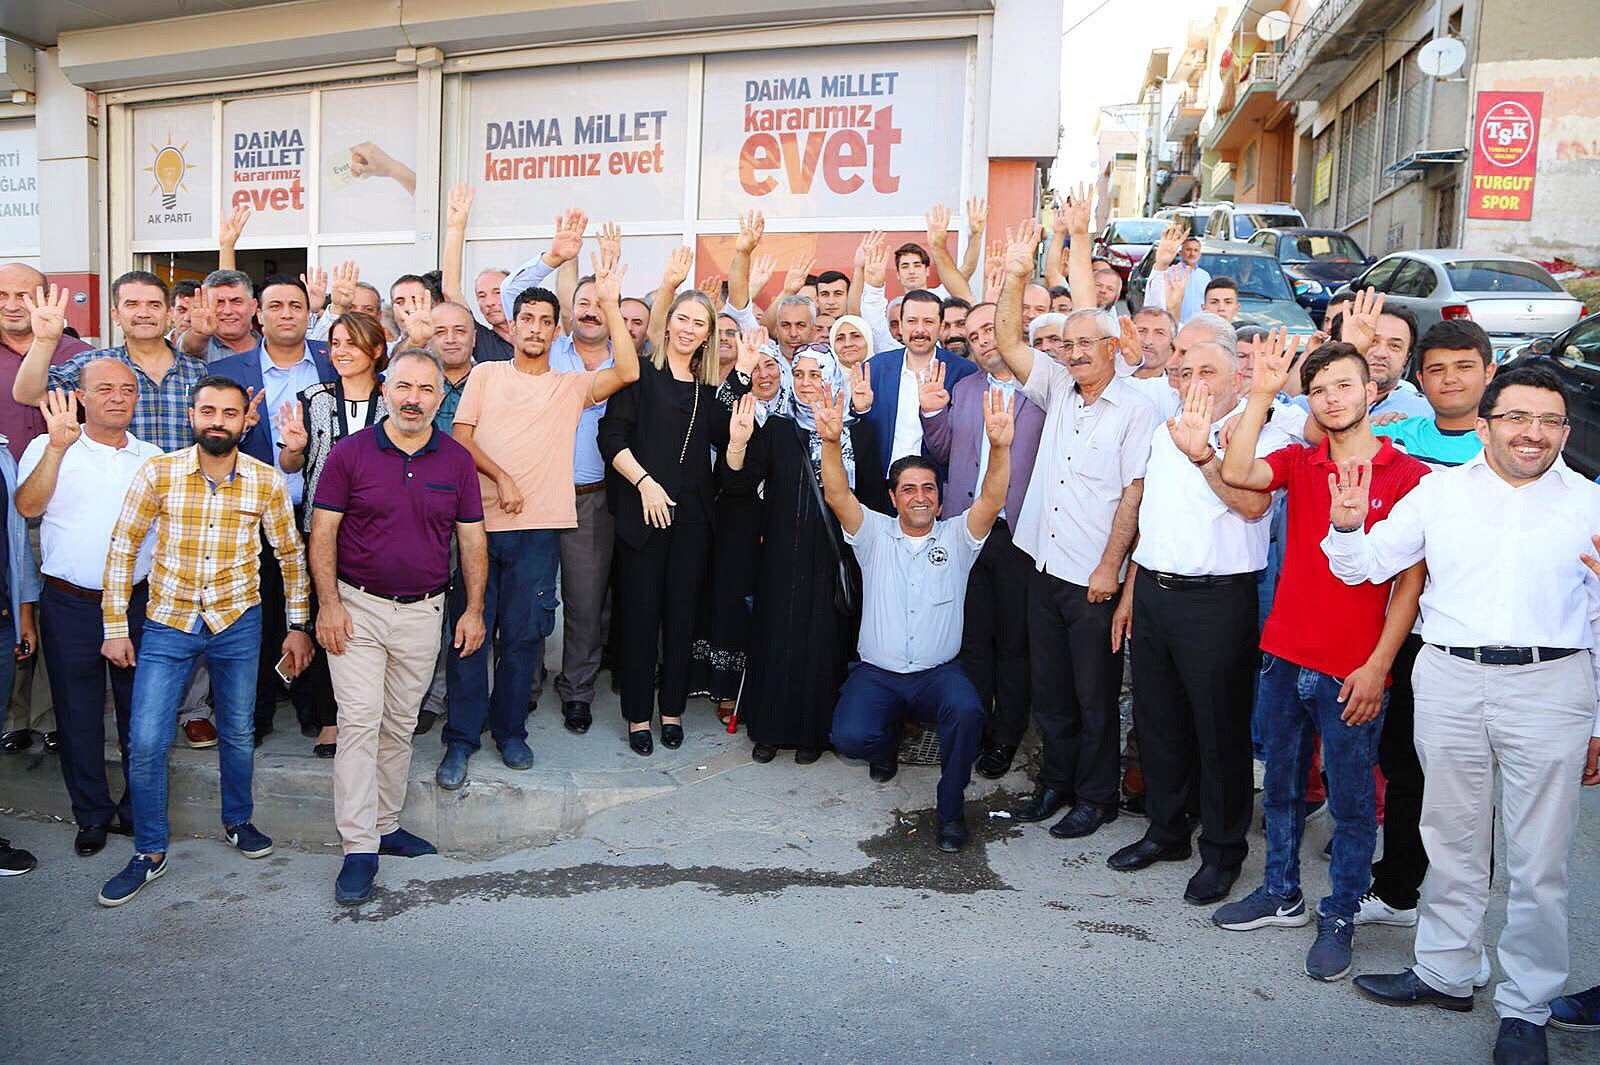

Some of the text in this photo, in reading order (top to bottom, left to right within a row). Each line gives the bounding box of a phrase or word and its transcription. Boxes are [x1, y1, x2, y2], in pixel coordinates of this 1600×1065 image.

[744, 103, 873, 132] kararımız
[1486, 121, 1529, 146] TSK
[485, 142, 664, 181] kararımız evet
[738, 104, 902, 196] evet
[234, 169, 301, 182] kararımız
[1474, 175, 1533, 191] TURGUT
[232, 179, 305, 211] evet
[1481, 194, 1521, 210] SPOR
[148, 214, 162, 225] AK
